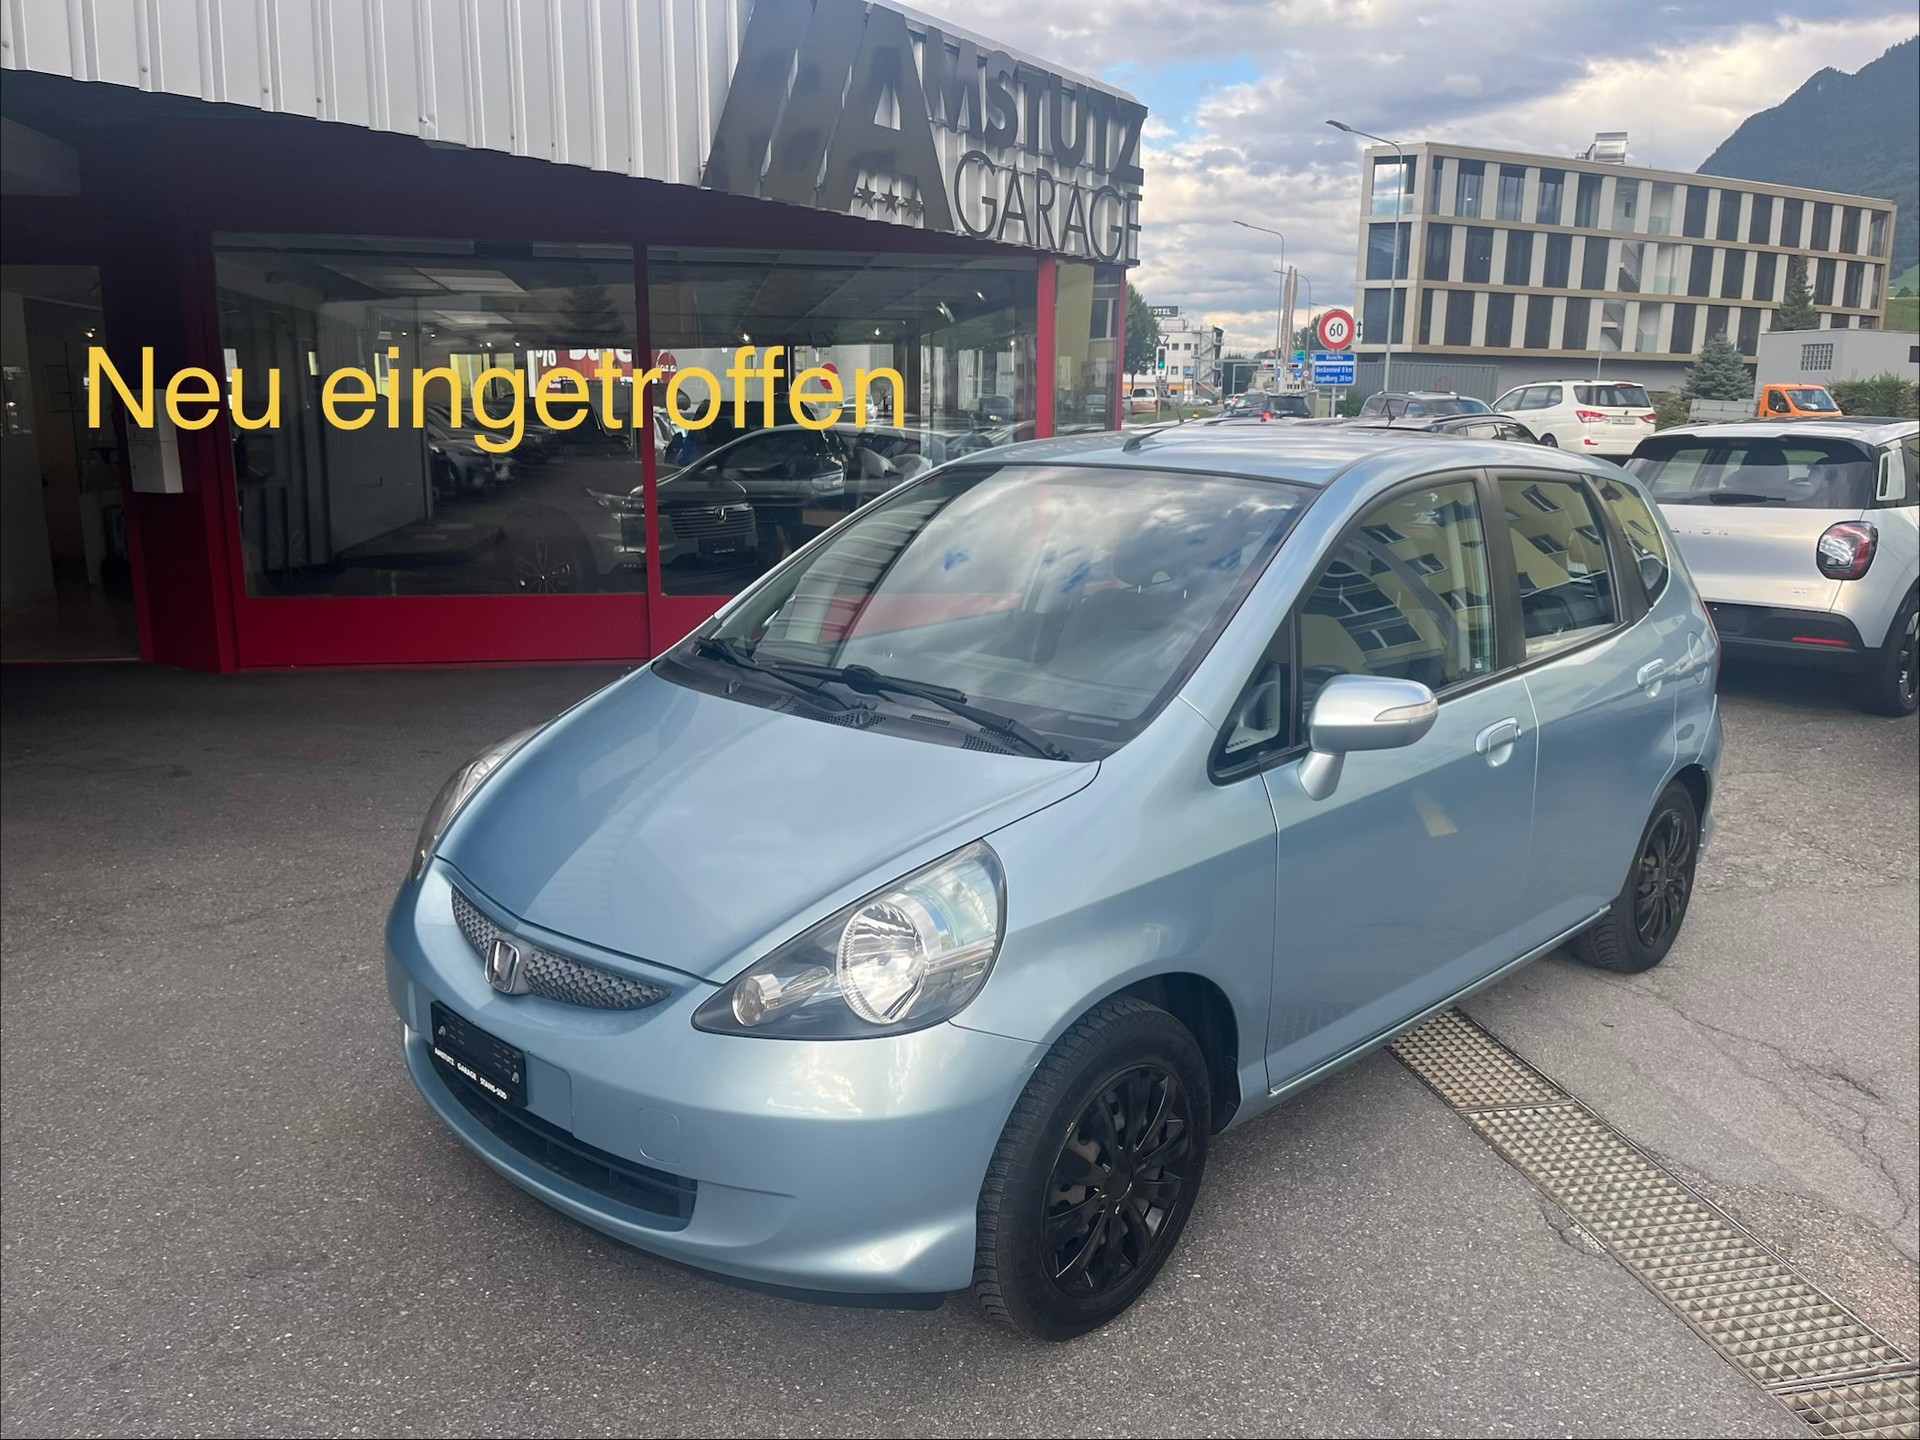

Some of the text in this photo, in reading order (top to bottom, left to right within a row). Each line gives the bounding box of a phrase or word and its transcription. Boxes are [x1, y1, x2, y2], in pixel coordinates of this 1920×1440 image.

[815, 3, 1148, 232] AMSTUTZ
[954, 150, 1142, 267] GARAGE
[1329, 323, 1344, 337] 60
